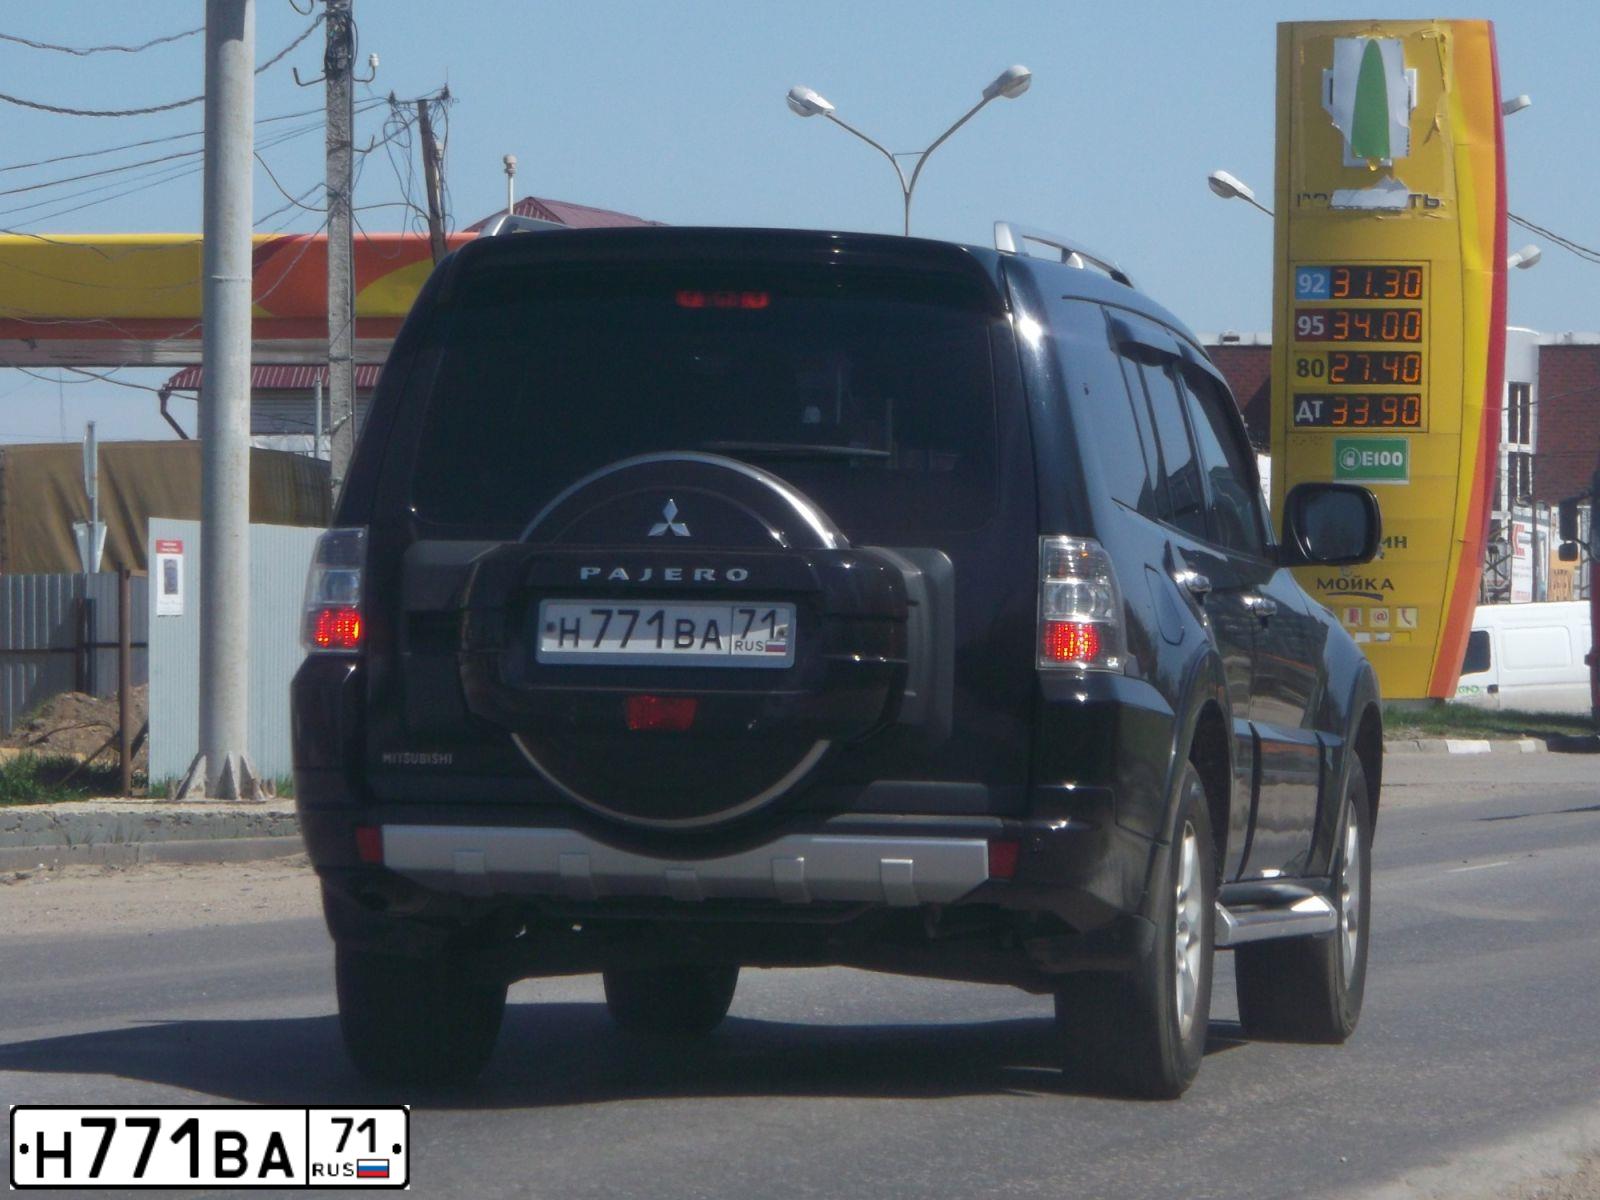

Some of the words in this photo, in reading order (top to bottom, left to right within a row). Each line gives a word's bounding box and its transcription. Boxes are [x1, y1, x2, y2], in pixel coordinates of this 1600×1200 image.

[1299, 273, 1326, 294] 92
[1333, 268, 1422, 298] 31.30
[1297, 315, 1325, 336] 95
[1332, 311, 1421, 341] 34.00
[1296, 358, 1325, 379] 80
[1331, 353, 1420, 383] 27.40
[1296, 400, 1324, 423] ДТ
[1332, 396, 1420, 426] 33.90
[1361, 451, 1404, 467] E100
[579, 566, 750, 582] PAJERO
[1316, 575, 1395, 592] МОЙКА
[738, 608, 778, 640] 71
[734, 639, 765, 652] RUS
[382, 751, 454, 765] MITSUBISHI
